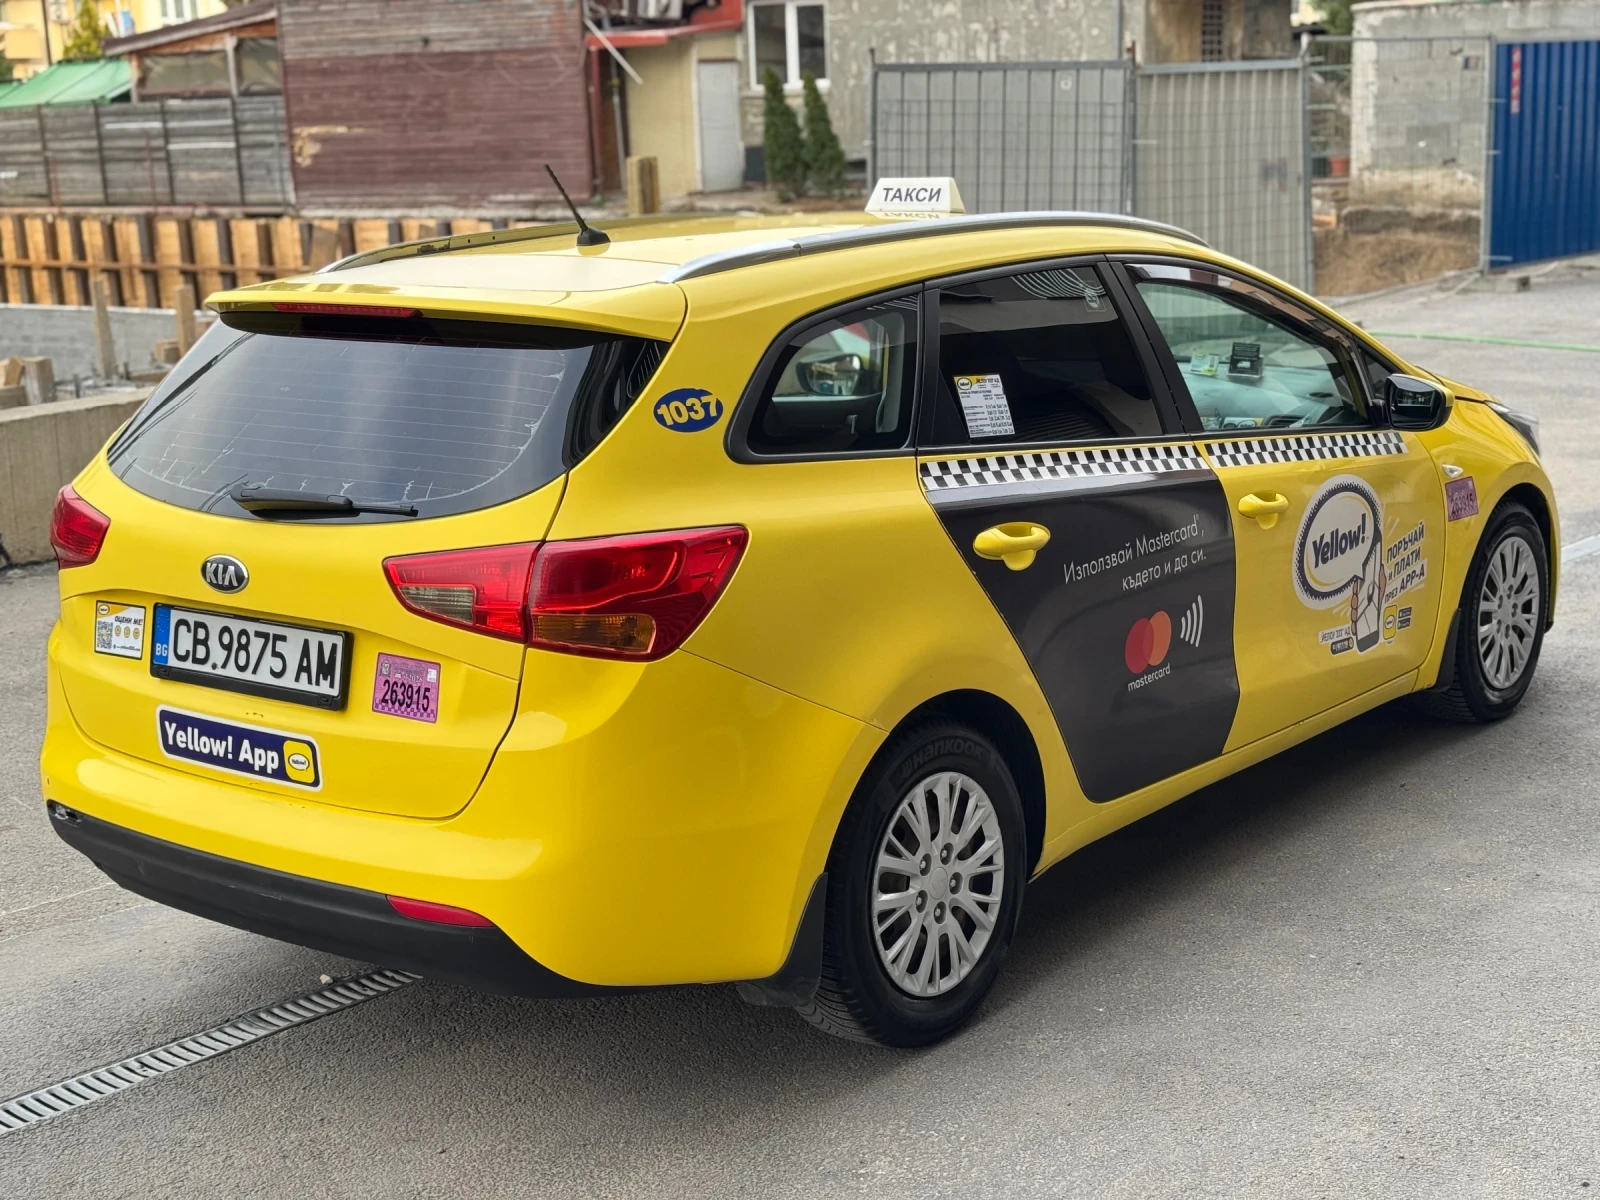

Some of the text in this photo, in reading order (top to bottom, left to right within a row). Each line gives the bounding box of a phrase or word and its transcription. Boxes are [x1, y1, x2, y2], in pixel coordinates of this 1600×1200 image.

[883, 187, 942, 202] ТАКСИ
[656, 395, 717, 426] 1037
[1312, 513, 1367, 569] Yellow!
[1386, 522, 1425, 564] ПОРЪЧАЙ
[206, 562, 238, 586] KIA
[1063, 541, 1133, 584] Използвай
[1122, 548, 1207, 591] където и да си.
[1393, 547, 1421, 576] ПЛАТИ
[1384, 588, 1398, 604] ПРЕЗ
[156, 643, 168, 657] BG
[1127, 663, 1171, 692] mastercard
[381, 679, 431, 712] 263915
[165, 721, 279, 774] Yellow! App
